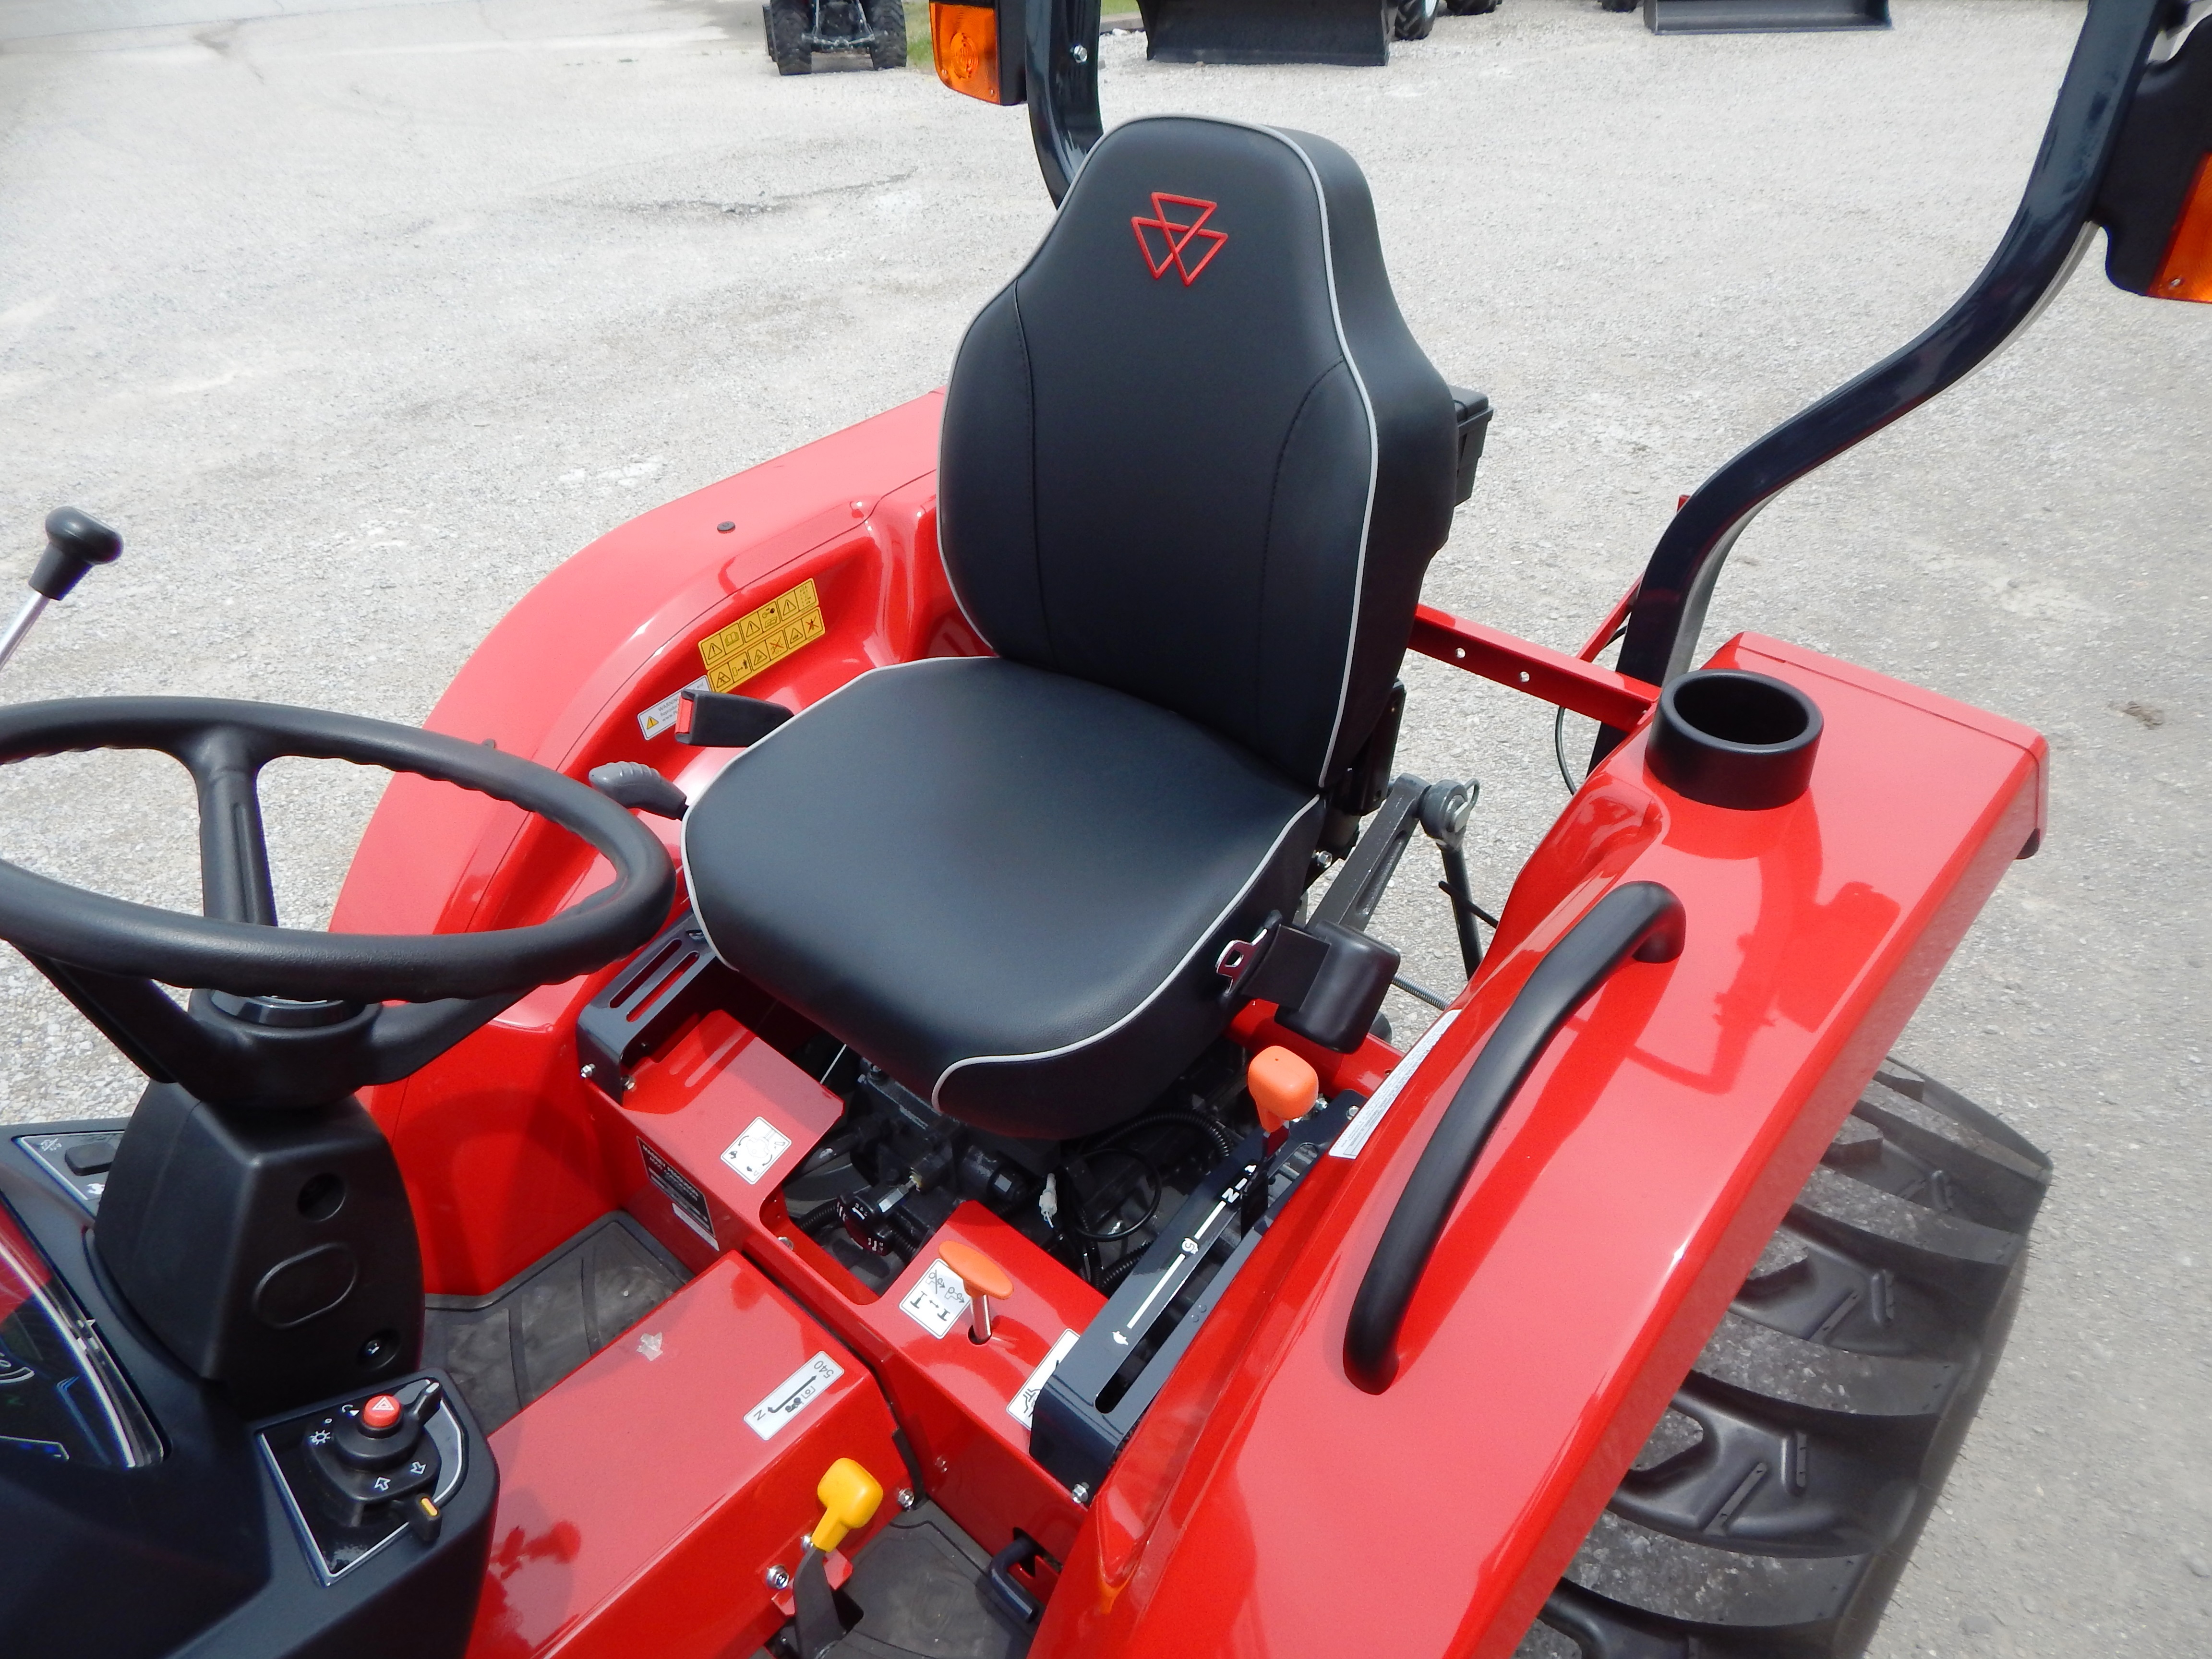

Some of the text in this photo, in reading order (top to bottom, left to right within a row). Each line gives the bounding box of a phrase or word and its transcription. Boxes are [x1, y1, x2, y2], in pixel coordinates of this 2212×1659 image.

[1222, 1188, 1239, 1203] N
[814, 1360, 834, 1379] 540
[753, 1409, 766, 1421] N
